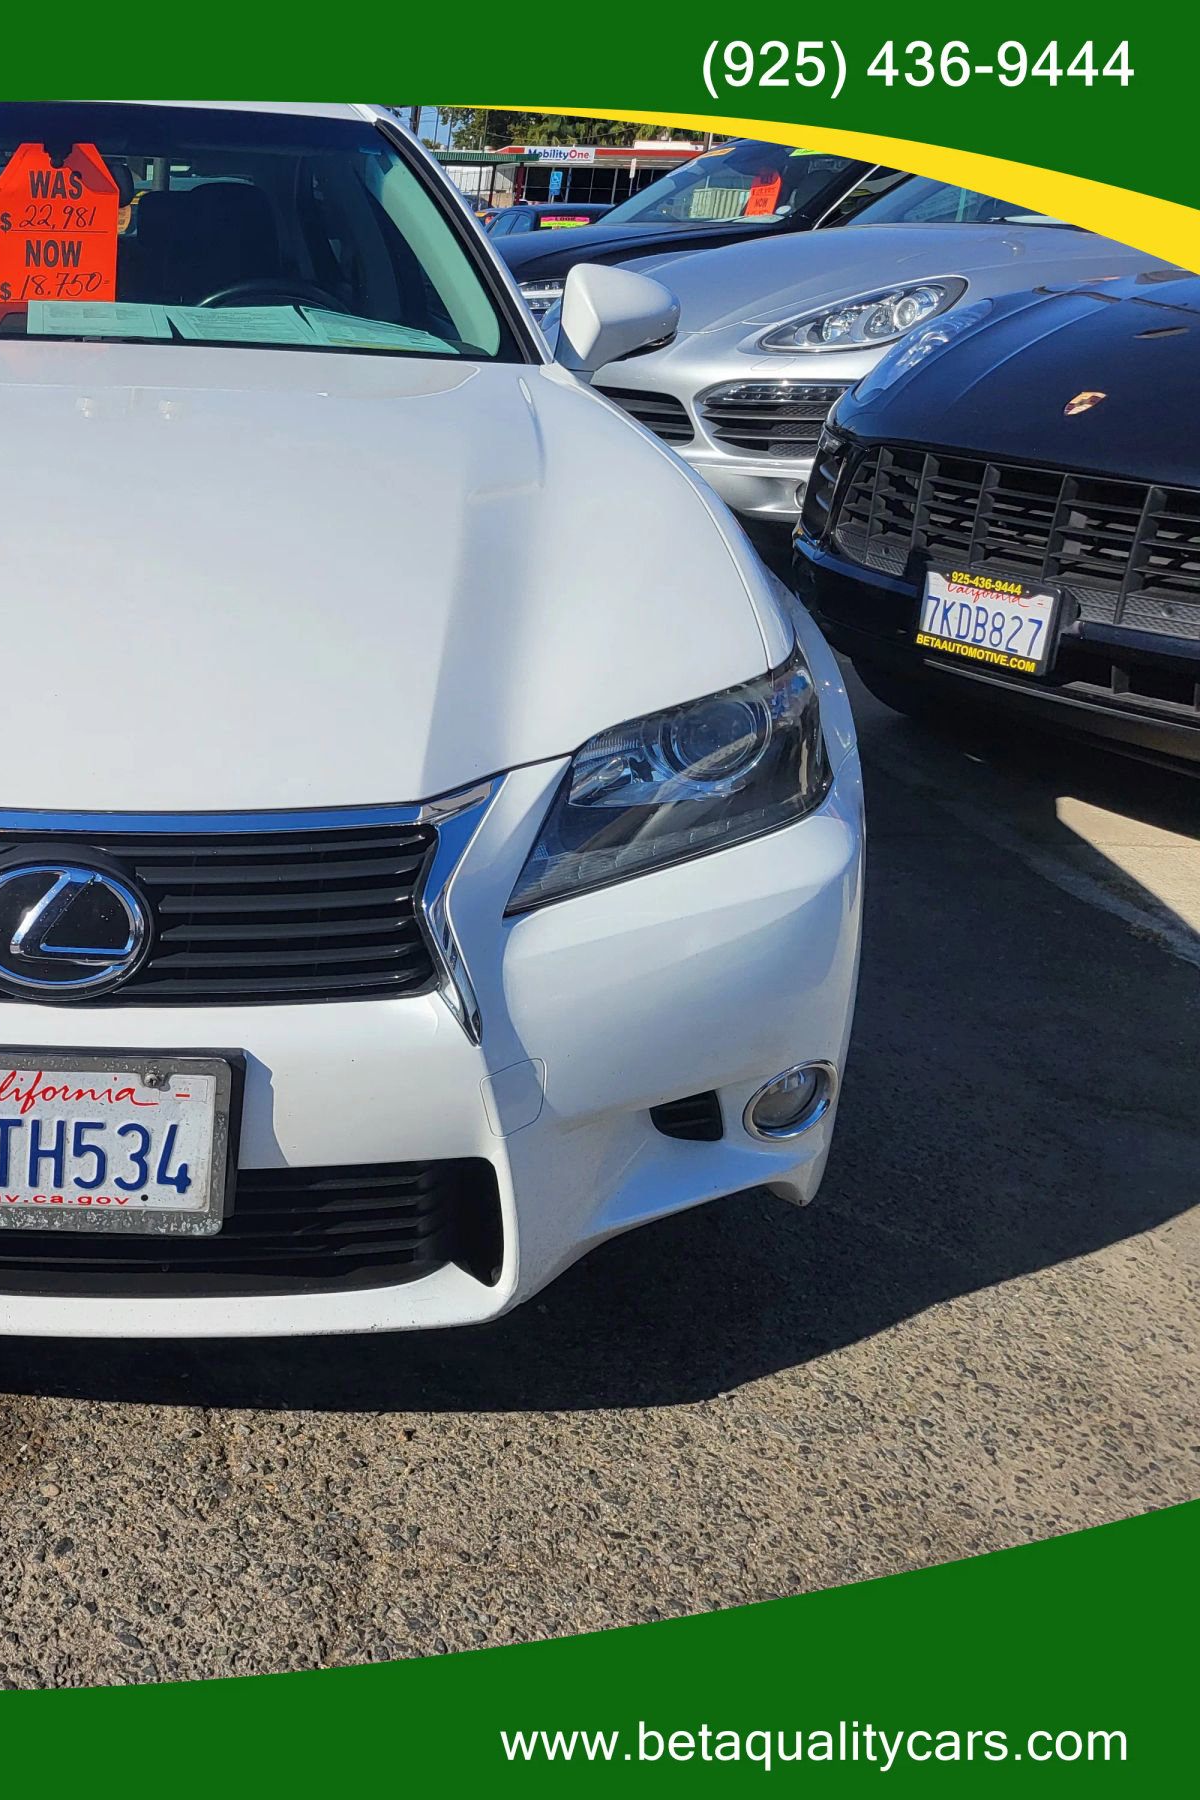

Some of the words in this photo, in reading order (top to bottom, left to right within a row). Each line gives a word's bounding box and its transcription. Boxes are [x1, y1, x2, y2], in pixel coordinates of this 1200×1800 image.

[29, 170, 83, 200] WAS
[0, 212, 12, 233] $
[19, 203, 98, 230] 22,981
[25, 239, 83, 268] NOW
[0, 281, 12, 302] $
[947, 583, 1033, 607] California
[951, 571, 1023, 595] 925-436-9444
[927, 595, 1044, 656] 7KDB827
[915, 633, 1036, 673] BETAAUTOMOTIVE.COM
